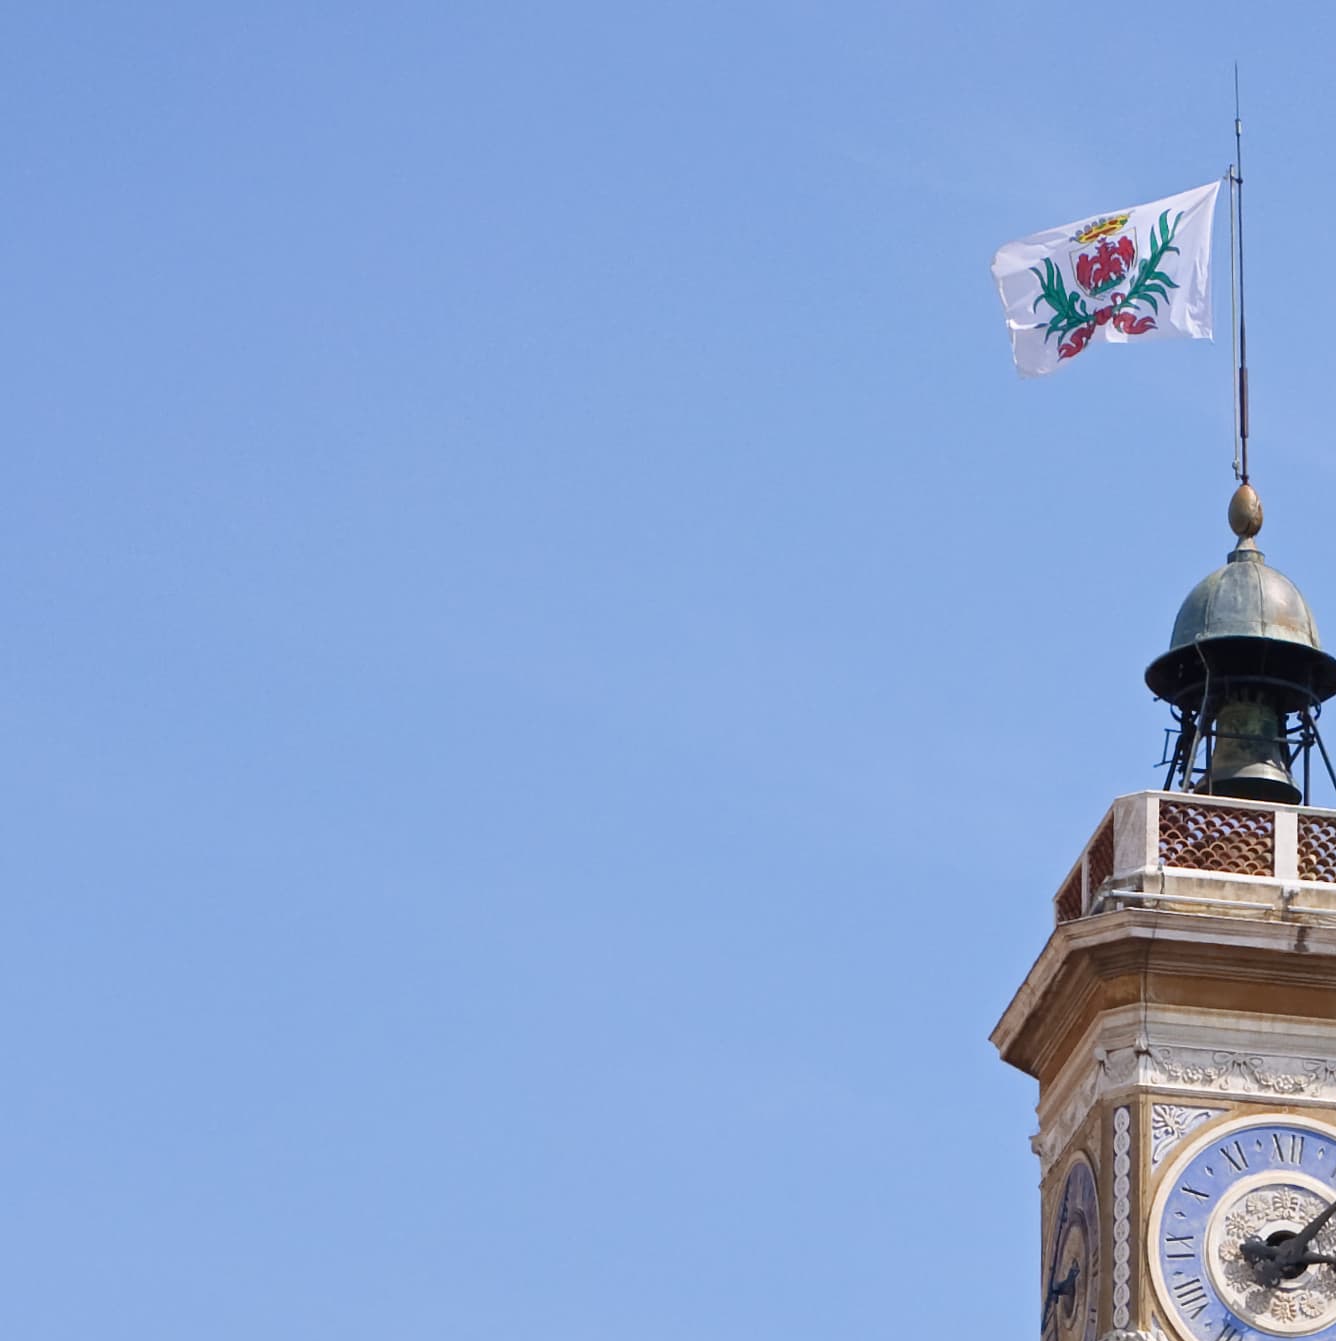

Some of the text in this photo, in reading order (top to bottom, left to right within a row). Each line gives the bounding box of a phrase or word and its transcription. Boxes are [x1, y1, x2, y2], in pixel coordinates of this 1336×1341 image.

[1220, 1140, 1249, 1170] XI
[1272, 1133, 1304, 1165] XII
[1181, 1181, 1210, 1205] X
[1165, 1232, 1195, 1259] IX
[1174, 1278, 1209, 1320] VIII
